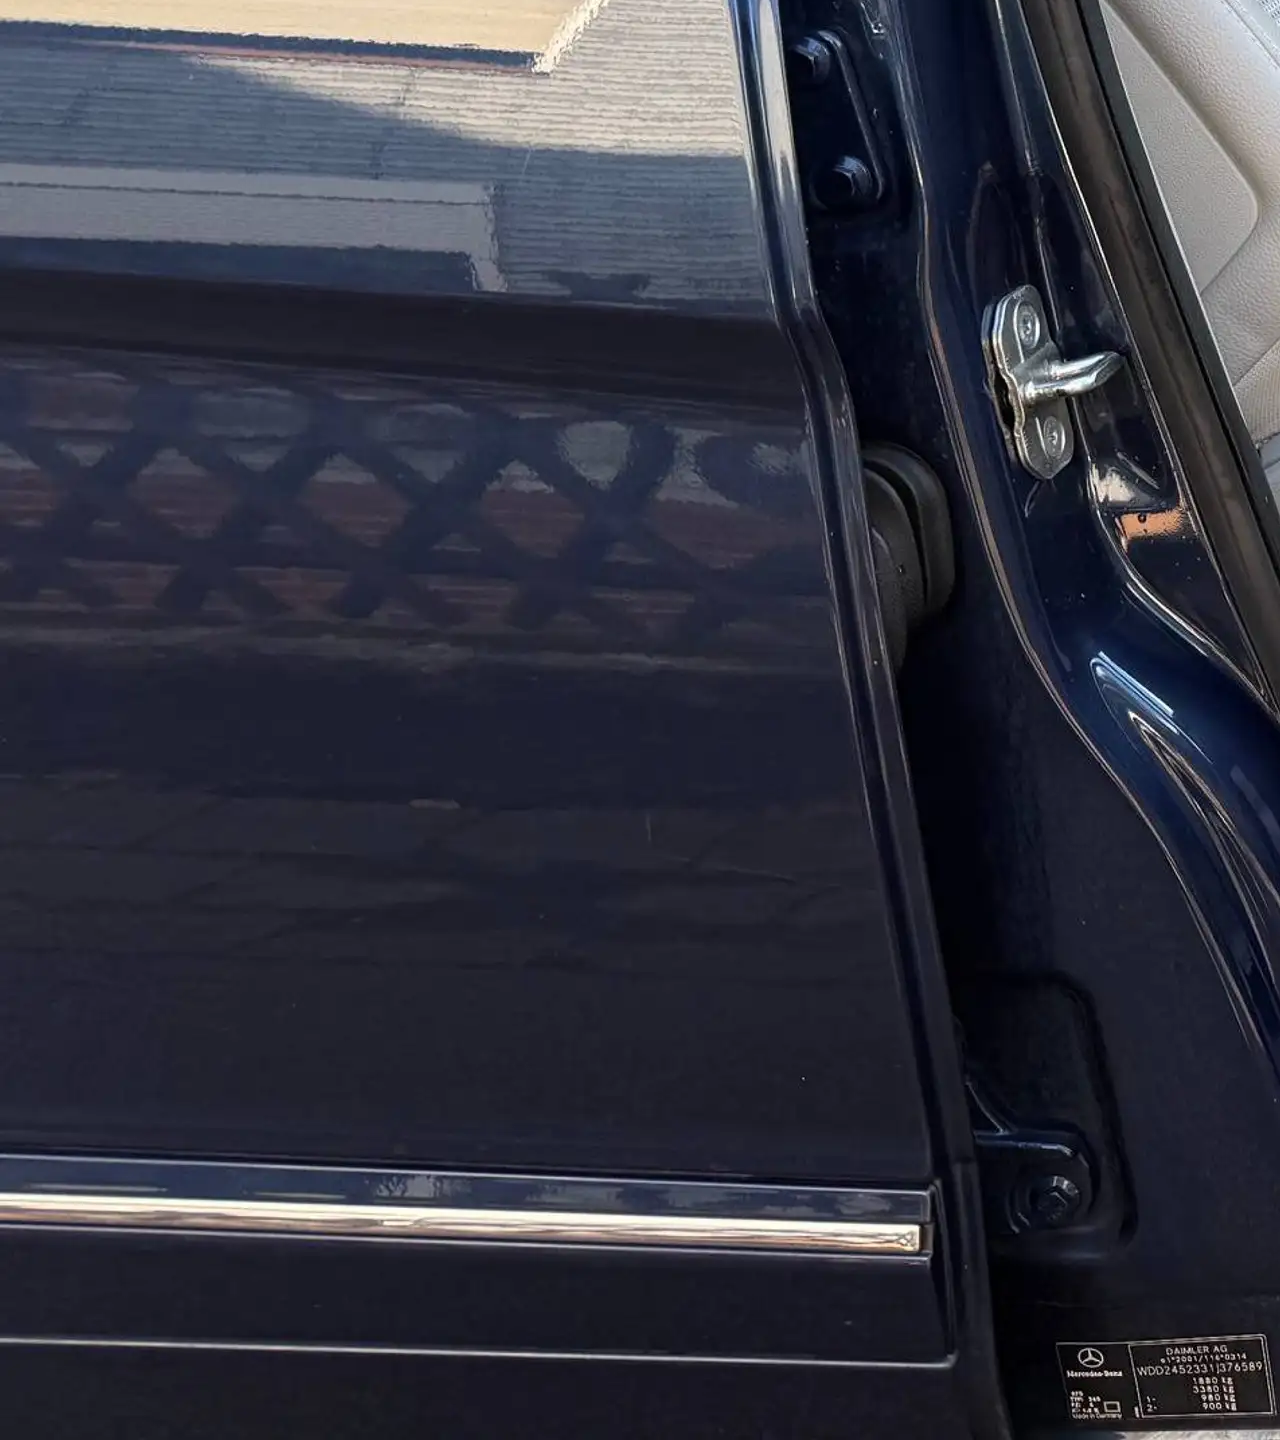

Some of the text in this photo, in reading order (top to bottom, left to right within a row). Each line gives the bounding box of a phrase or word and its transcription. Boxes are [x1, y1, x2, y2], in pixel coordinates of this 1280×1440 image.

[1166, 1345, 1228, 1356] DAIMLER AG
[1136, 1361, 1263, 1376] WDD2452331J376589
